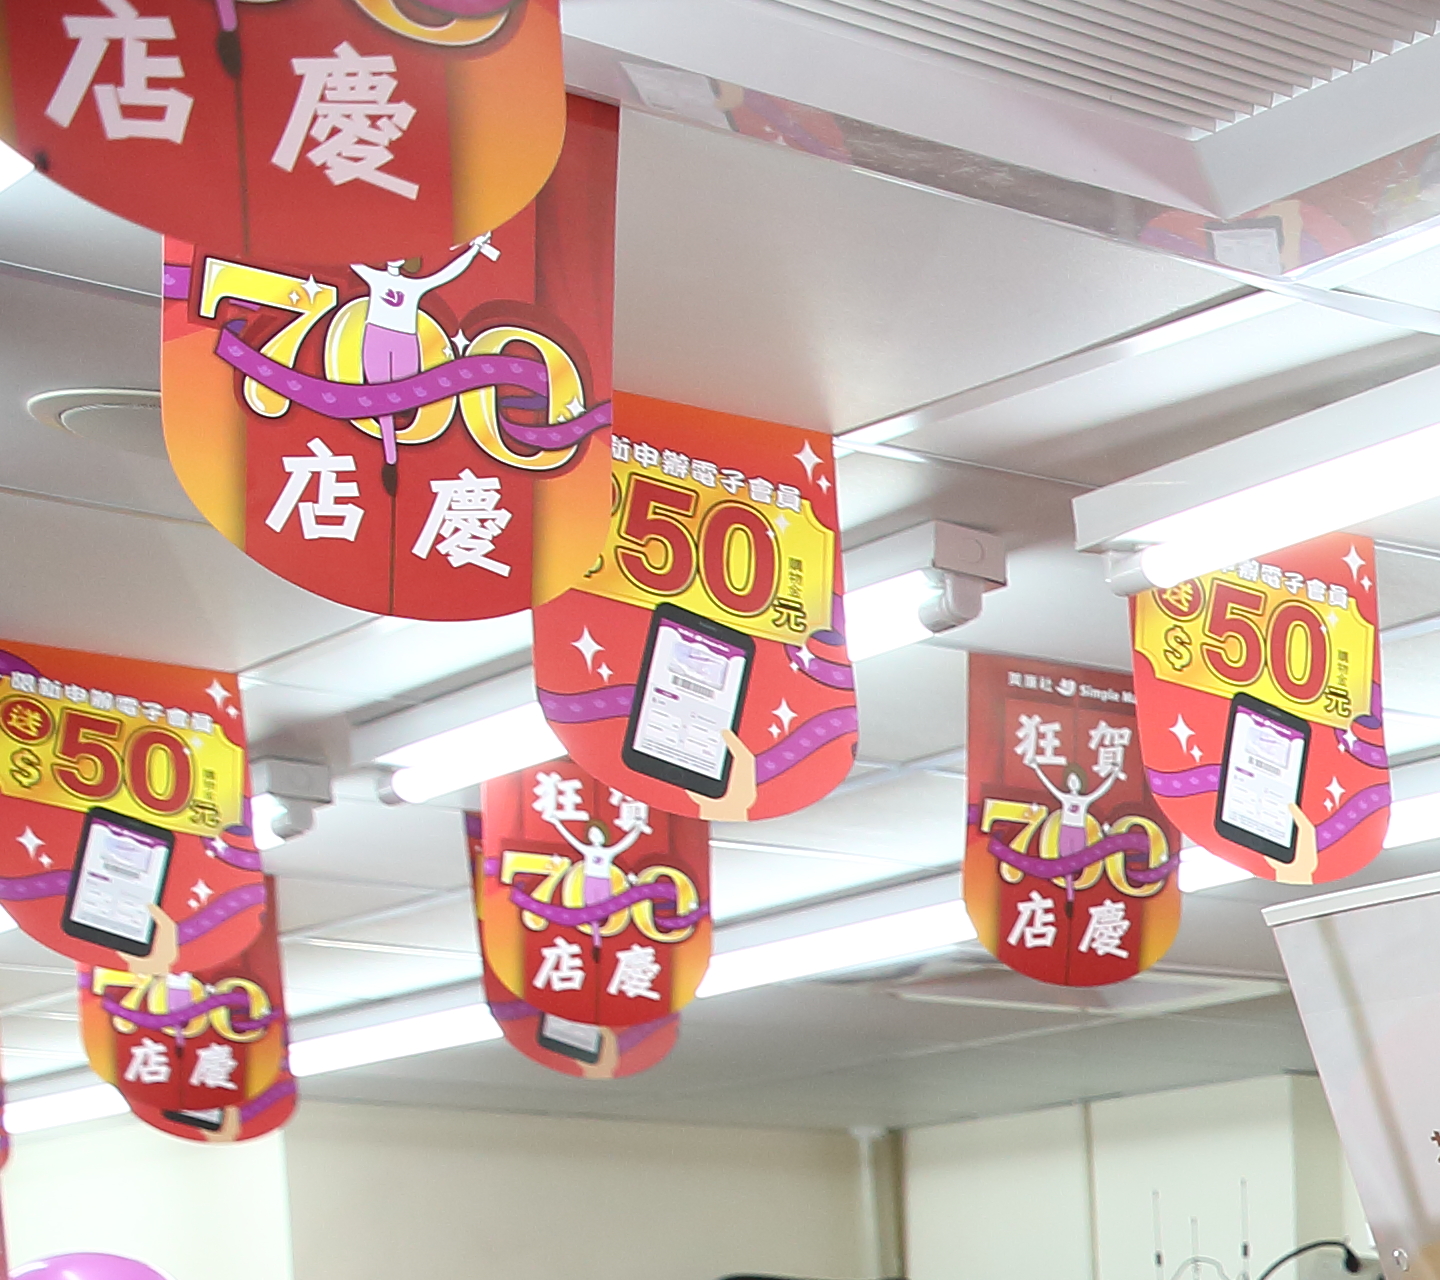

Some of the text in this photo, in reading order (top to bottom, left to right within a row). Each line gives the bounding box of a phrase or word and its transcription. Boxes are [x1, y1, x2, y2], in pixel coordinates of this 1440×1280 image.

[265, 437, 512, 577] 店慶
[620, 478, 782, 616] 50
[1203, 585, 1352, 716] 50 元
[7, 703, 44, 737] 送
[1014, 714, 1132, 782] 狂賀
[53, 709, 193, 813] 50
[1008, 891, 1131, 958] 店慶
[532, 937, 661, 1000] 店慶
[125, 1037, 239, 1091] 店慶
